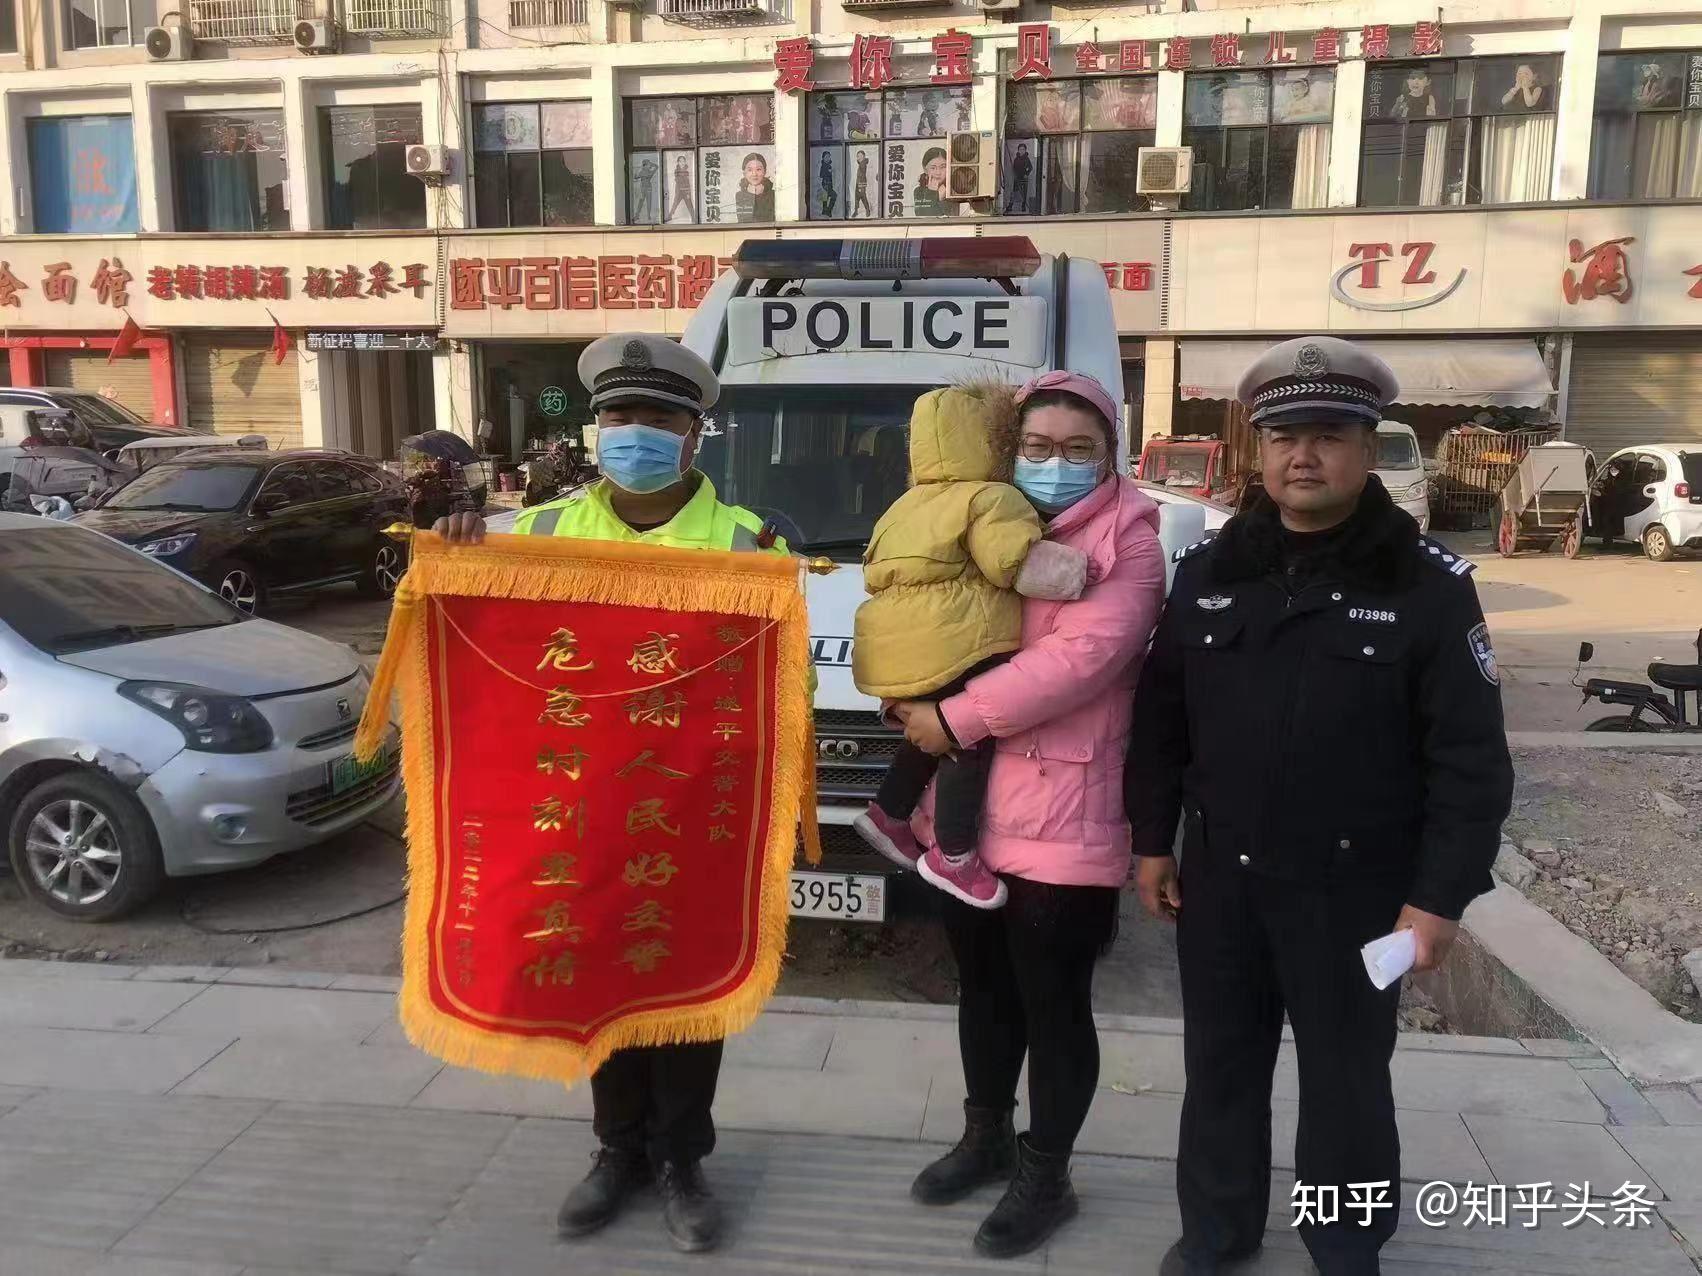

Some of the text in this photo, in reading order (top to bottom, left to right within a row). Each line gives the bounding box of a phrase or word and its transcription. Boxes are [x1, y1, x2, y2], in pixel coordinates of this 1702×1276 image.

[773, 22, 1443, 92] 爱你宝贝 全国连锁儿童摄影
[704, 151, 721, 222] 爱你宝贝
[888, 144, 905, 218] 爱你宝贝
[1348, 242, 1437, 288] TZ
[762, 301, 1010, 350] POLICE
[542, 388, 565, 413] 药
[1349, 608, 1396, 622] 073986
[815, 739, 859, 760] CO
[614, 630, 694, 976] 感谢人民好交警
